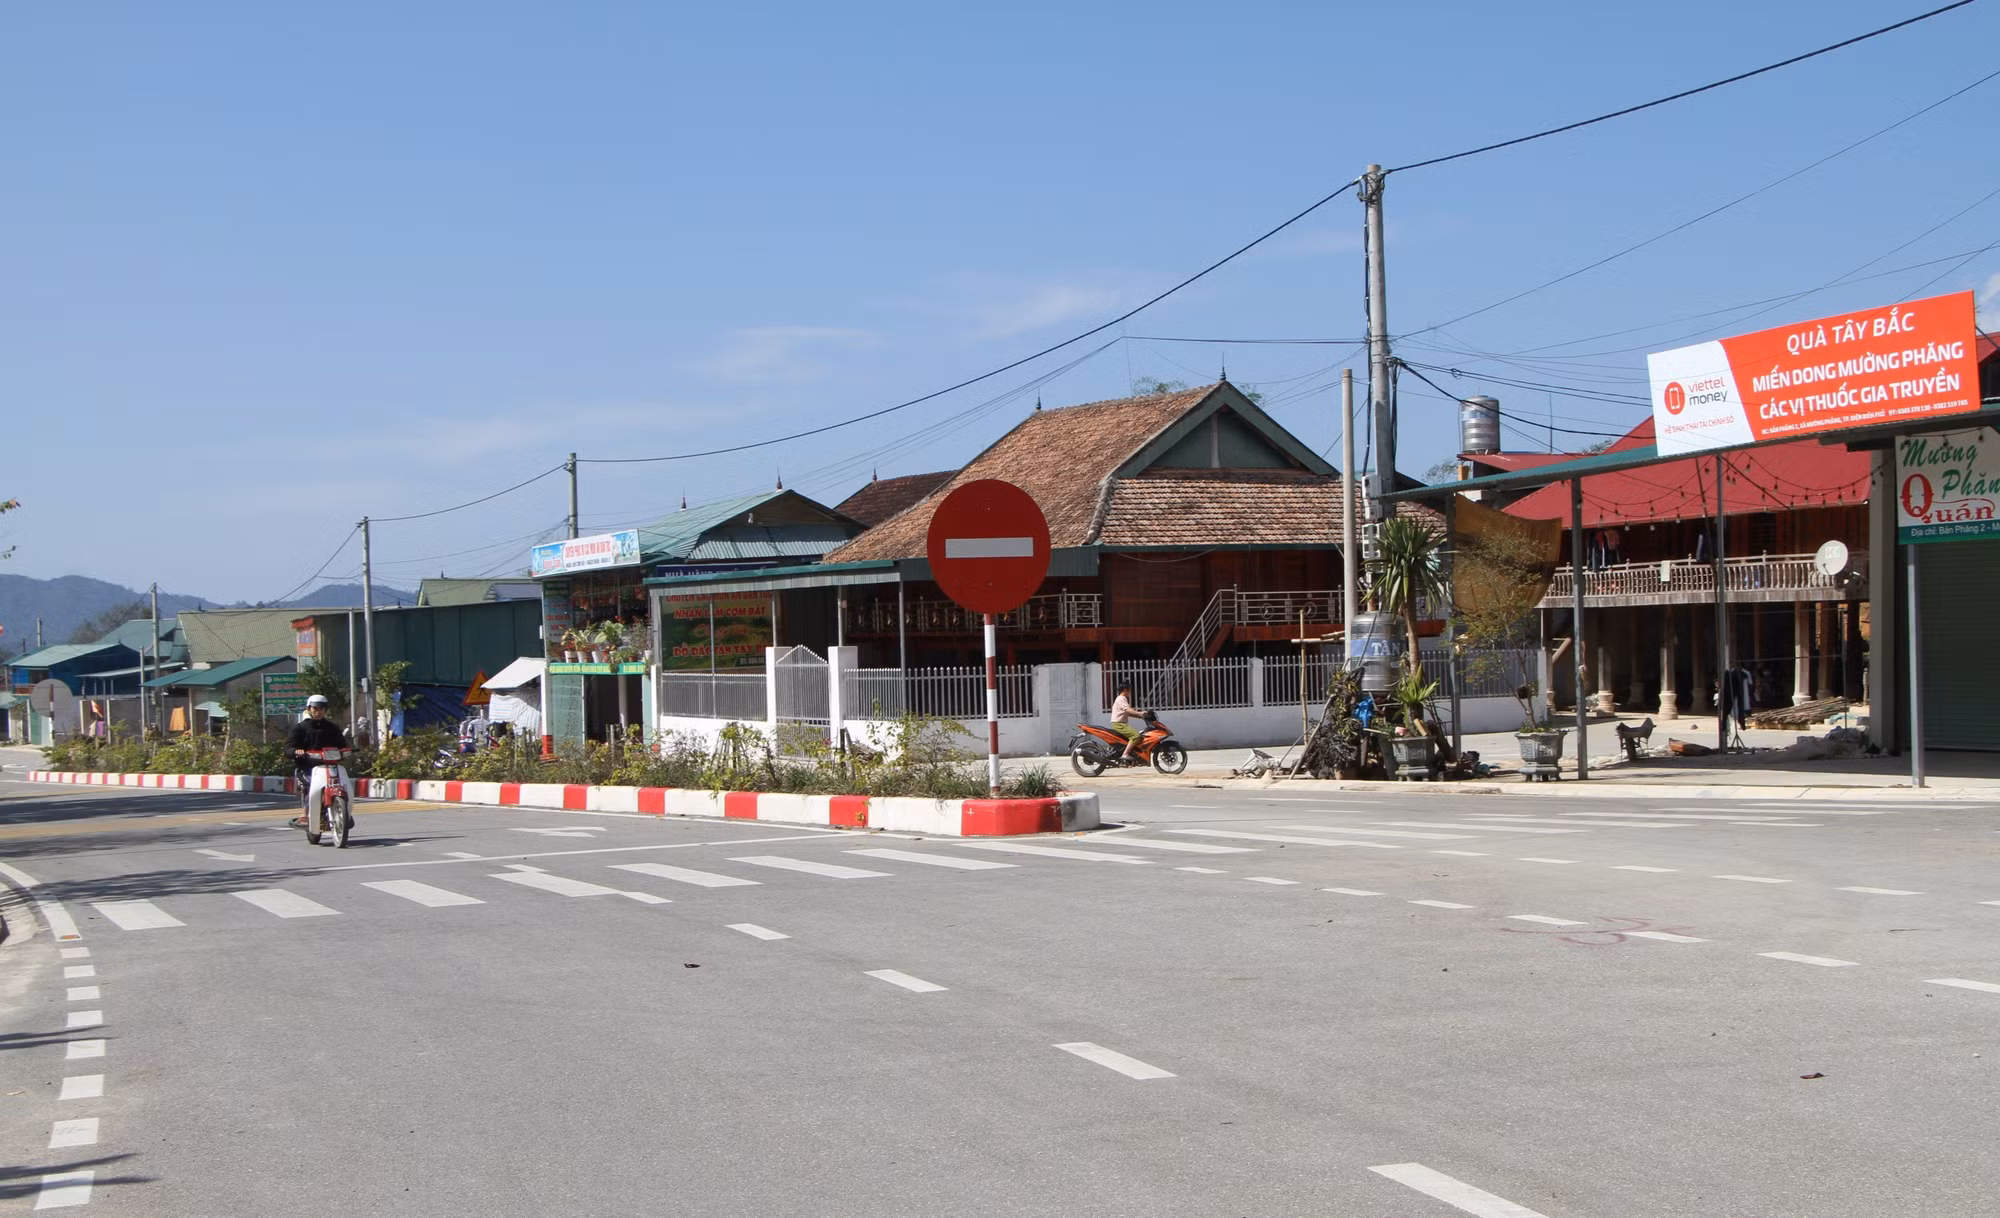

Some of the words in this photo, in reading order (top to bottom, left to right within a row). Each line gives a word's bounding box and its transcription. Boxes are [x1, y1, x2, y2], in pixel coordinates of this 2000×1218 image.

[1787, 325, 1827, 355] QUÀ
[1832, 320, 1868, 344] TÂY
[1872, 307, 1915, 337] BẮC
[1688, 377, 1725, 393] viettel
[1752, 365, 1790, 393] MIẾN
[1792, 363, 1836, 385] DONG
[1838, 351, 1901, 378] MƯỜNG
[1902, 341, 1964, 367] PHĂNG
[1689, 391, 1728, 406] money
[1759, 397, 1788, 420] CÁC
[1789, 398, 1806, 417] VỊ
[1806, 382, 1859, 413] THUỐC
[1861, 384, 1888, 404] GIA
[1890, 367, 1960, 399] TRUYỀN
[1899, 473, 1995, 524] Quán
[1911, 528, 1923, 537] Địa
[1939, 525, 1954, 534] Bản
[1955, 523, 1979, 534] Phăng
[1980, 523, 1986, 531] 2
